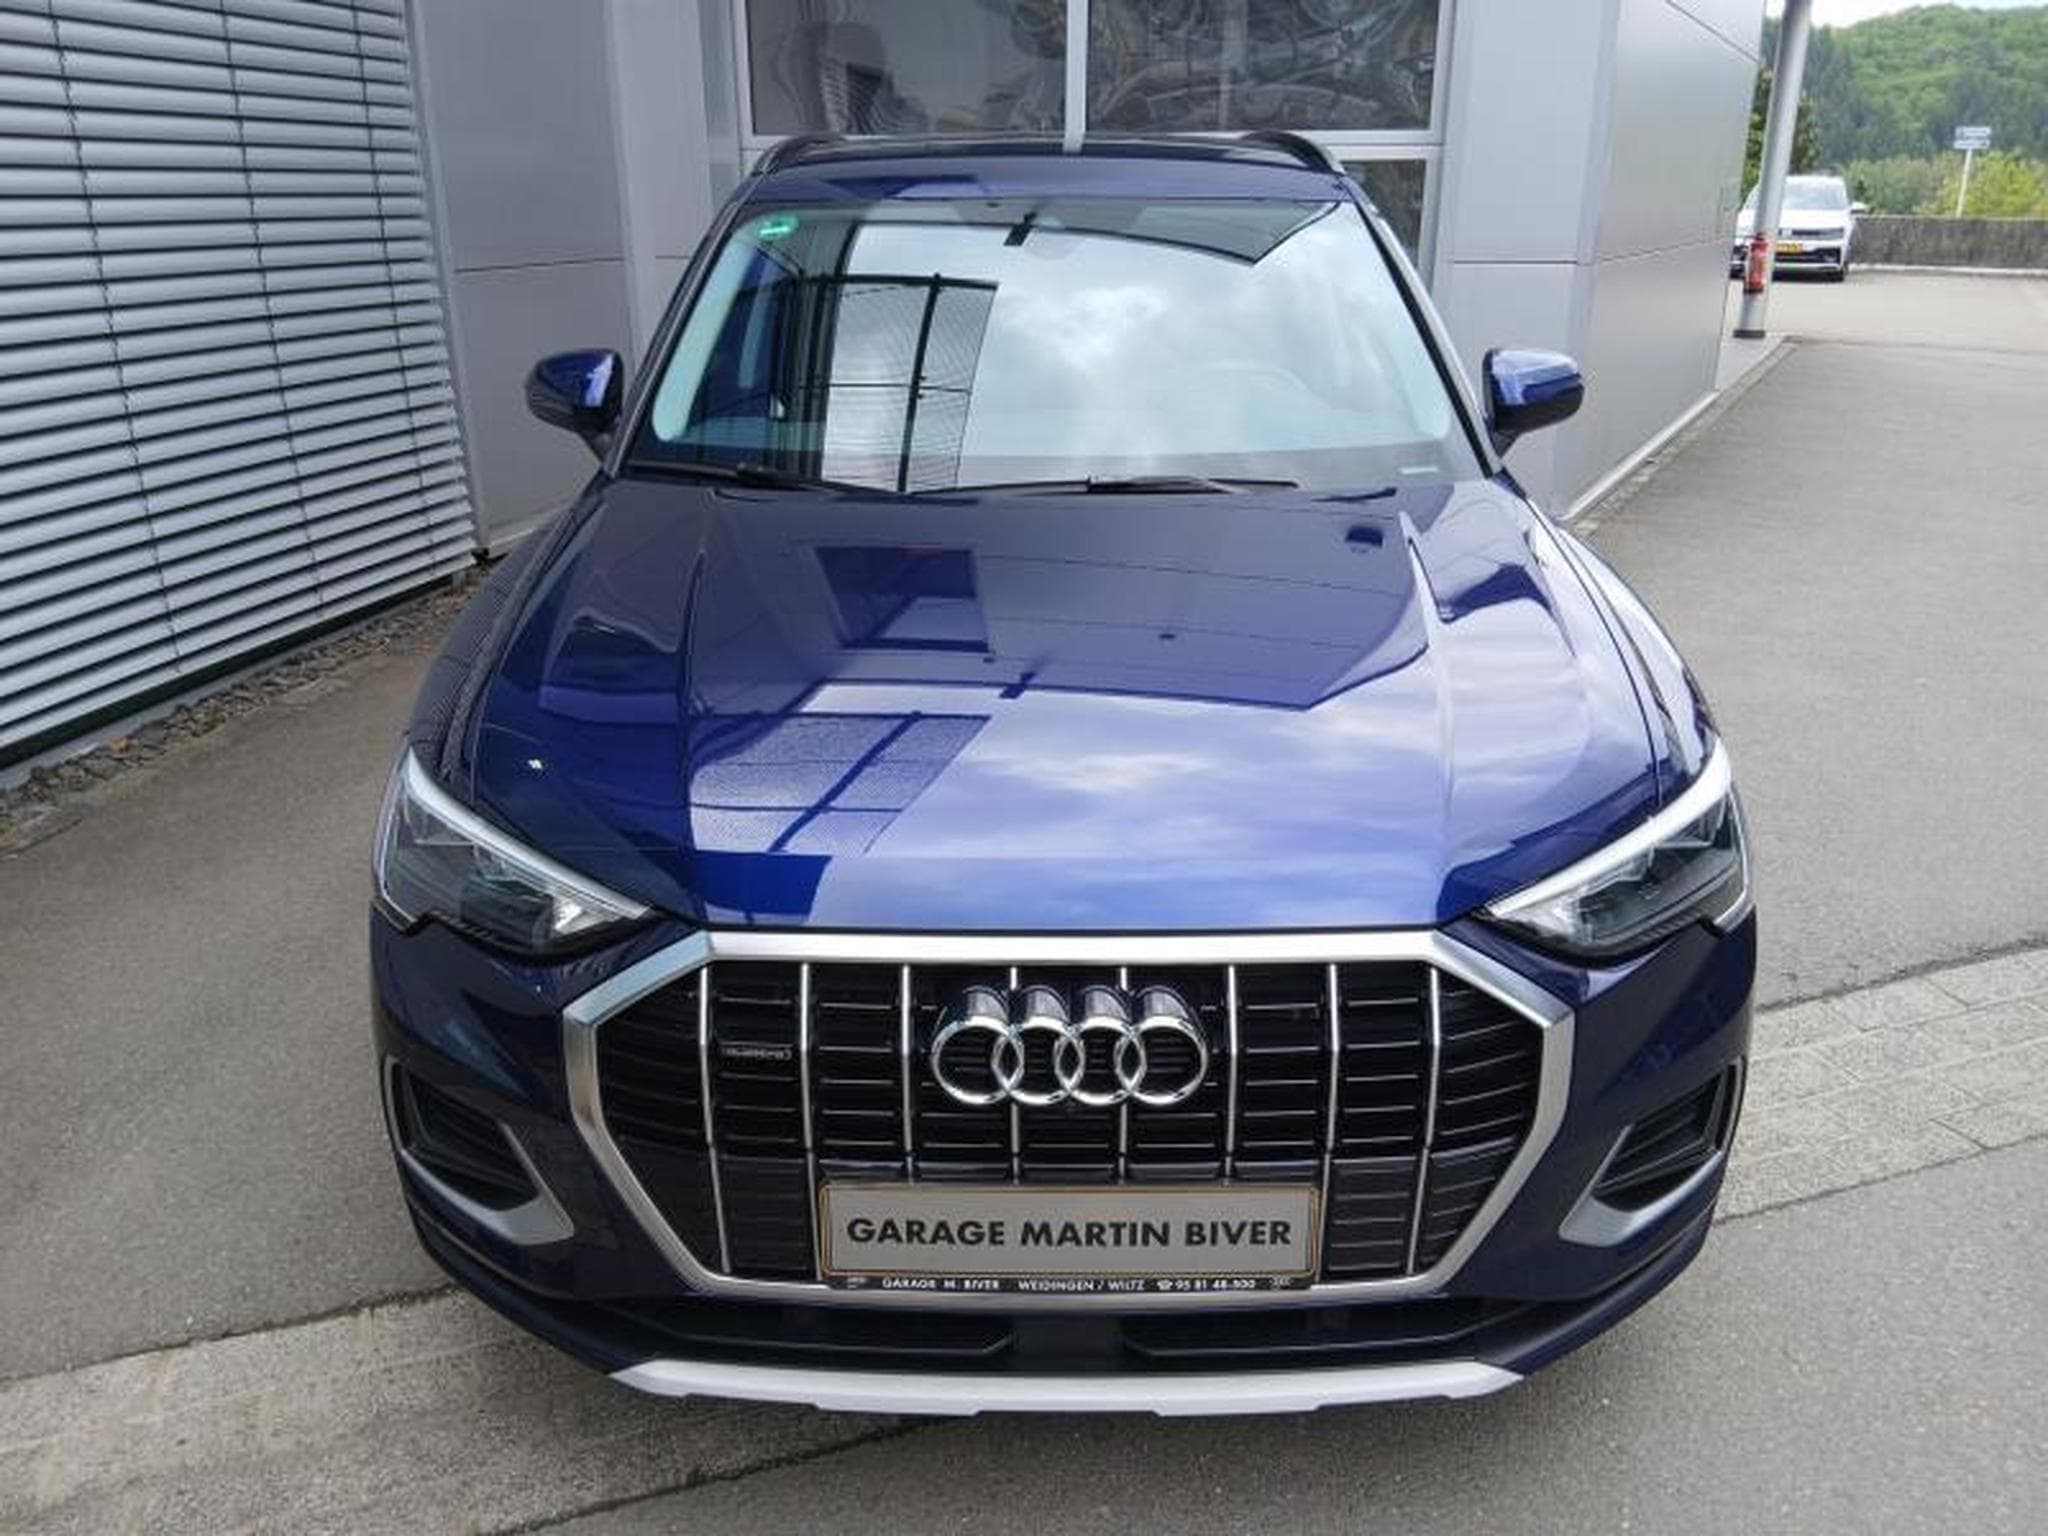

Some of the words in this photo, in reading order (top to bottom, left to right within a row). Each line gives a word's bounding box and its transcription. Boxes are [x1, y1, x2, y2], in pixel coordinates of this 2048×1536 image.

[847, 1217, 1005, 1246] GARAGE
[1020, 1219, 1170, 1247] MARTIN
[1185, 1220, 1291, 1246] BIVER
[882, 1279, 937, 1290] GARAGE
